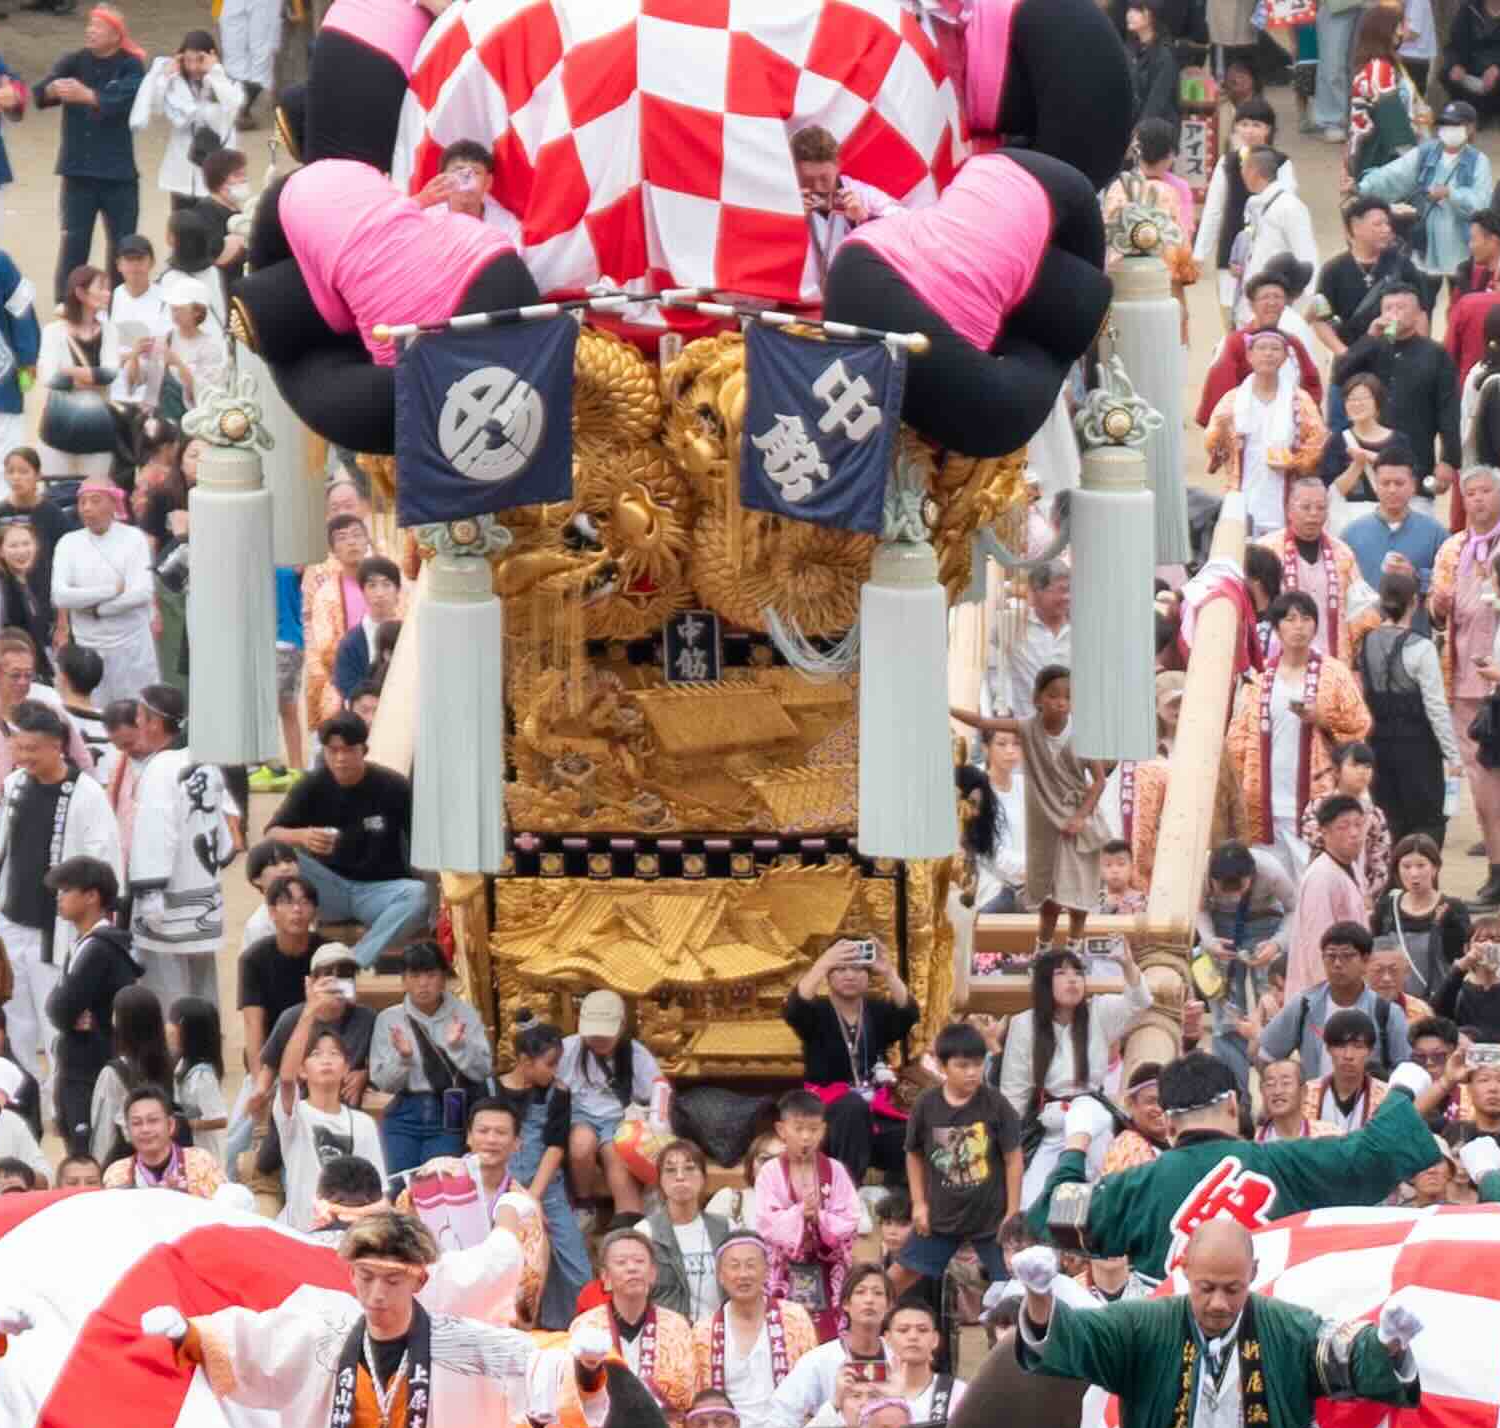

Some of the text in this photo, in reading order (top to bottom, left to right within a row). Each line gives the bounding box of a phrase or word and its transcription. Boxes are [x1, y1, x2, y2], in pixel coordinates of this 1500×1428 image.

[1182, 123, 1204, 175] アイス
[750, 359, 882, 503] 中筋
[675, 613, 707, 681] 中筋
